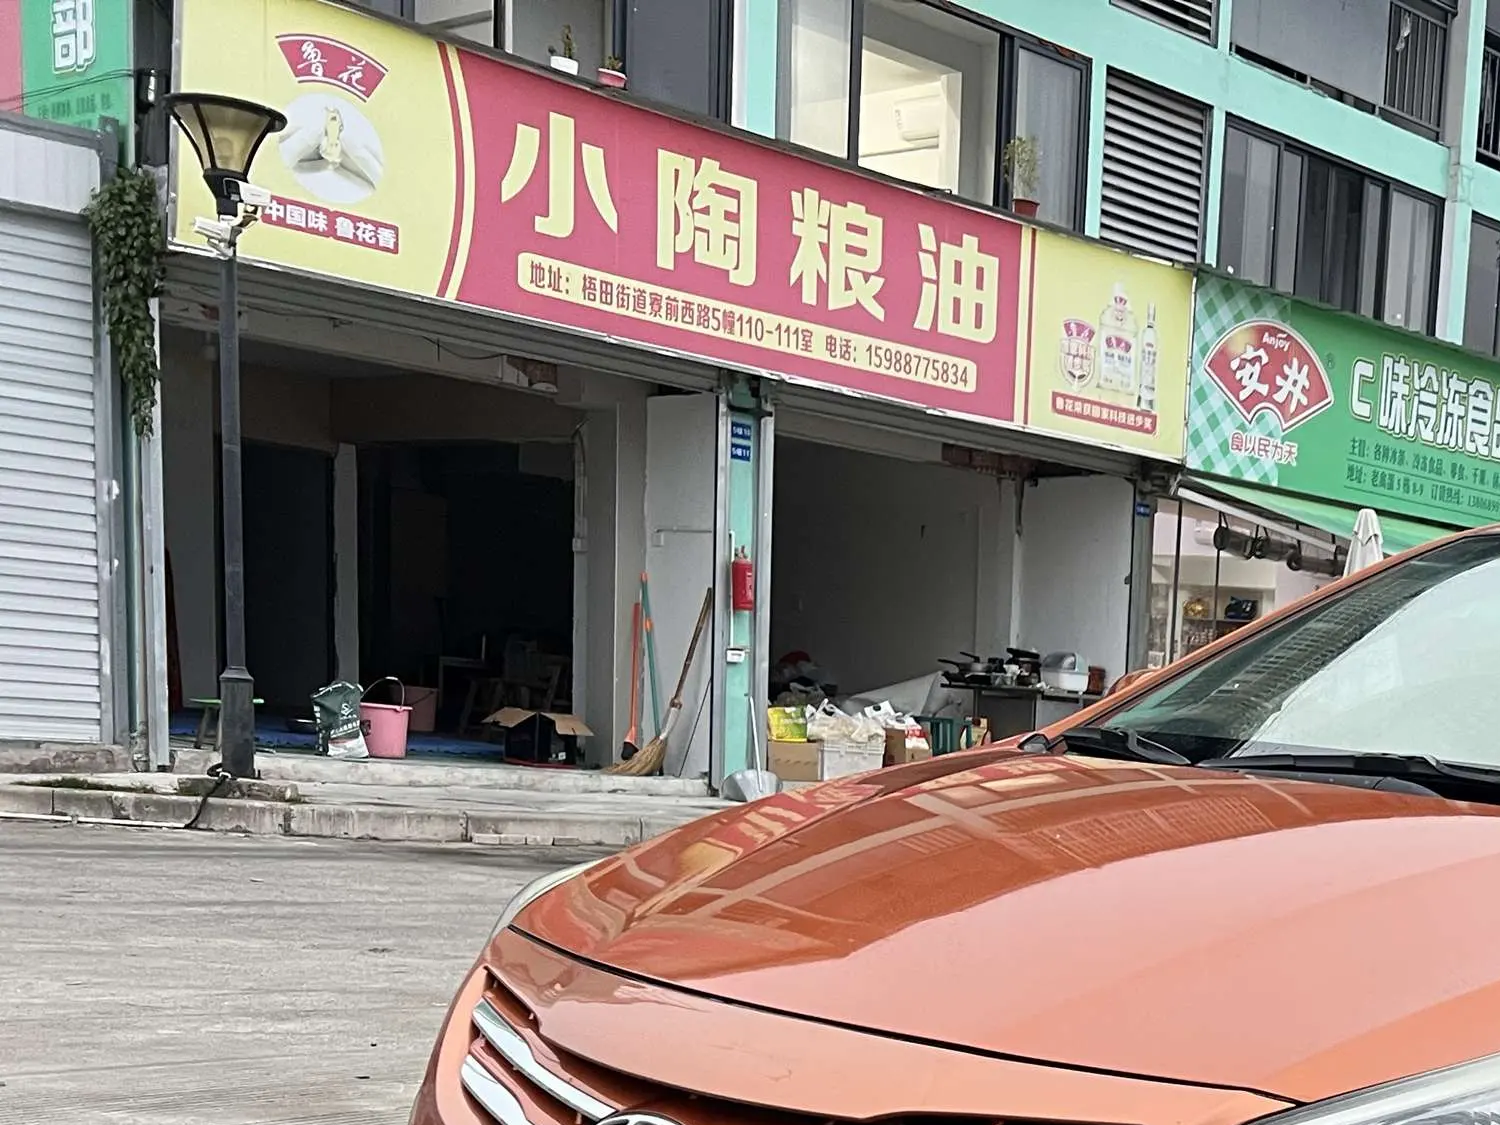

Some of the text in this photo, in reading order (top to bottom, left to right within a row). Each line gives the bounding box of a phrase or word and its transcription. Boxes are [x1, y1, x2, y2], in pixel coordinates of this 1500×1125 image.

[53, 0, 94, 71] 部
[297, 41, 366, 91] 鲁花
[265, 200, 397, 249] 中国味 鲁花香
[501, 111, 998, 343] 小陶粮油
[1262, 332, 1291, 352] Anjoy
[1230, 344, 1310, 414] 安井
[1231, 431, 1298, 464] 食以民为天
